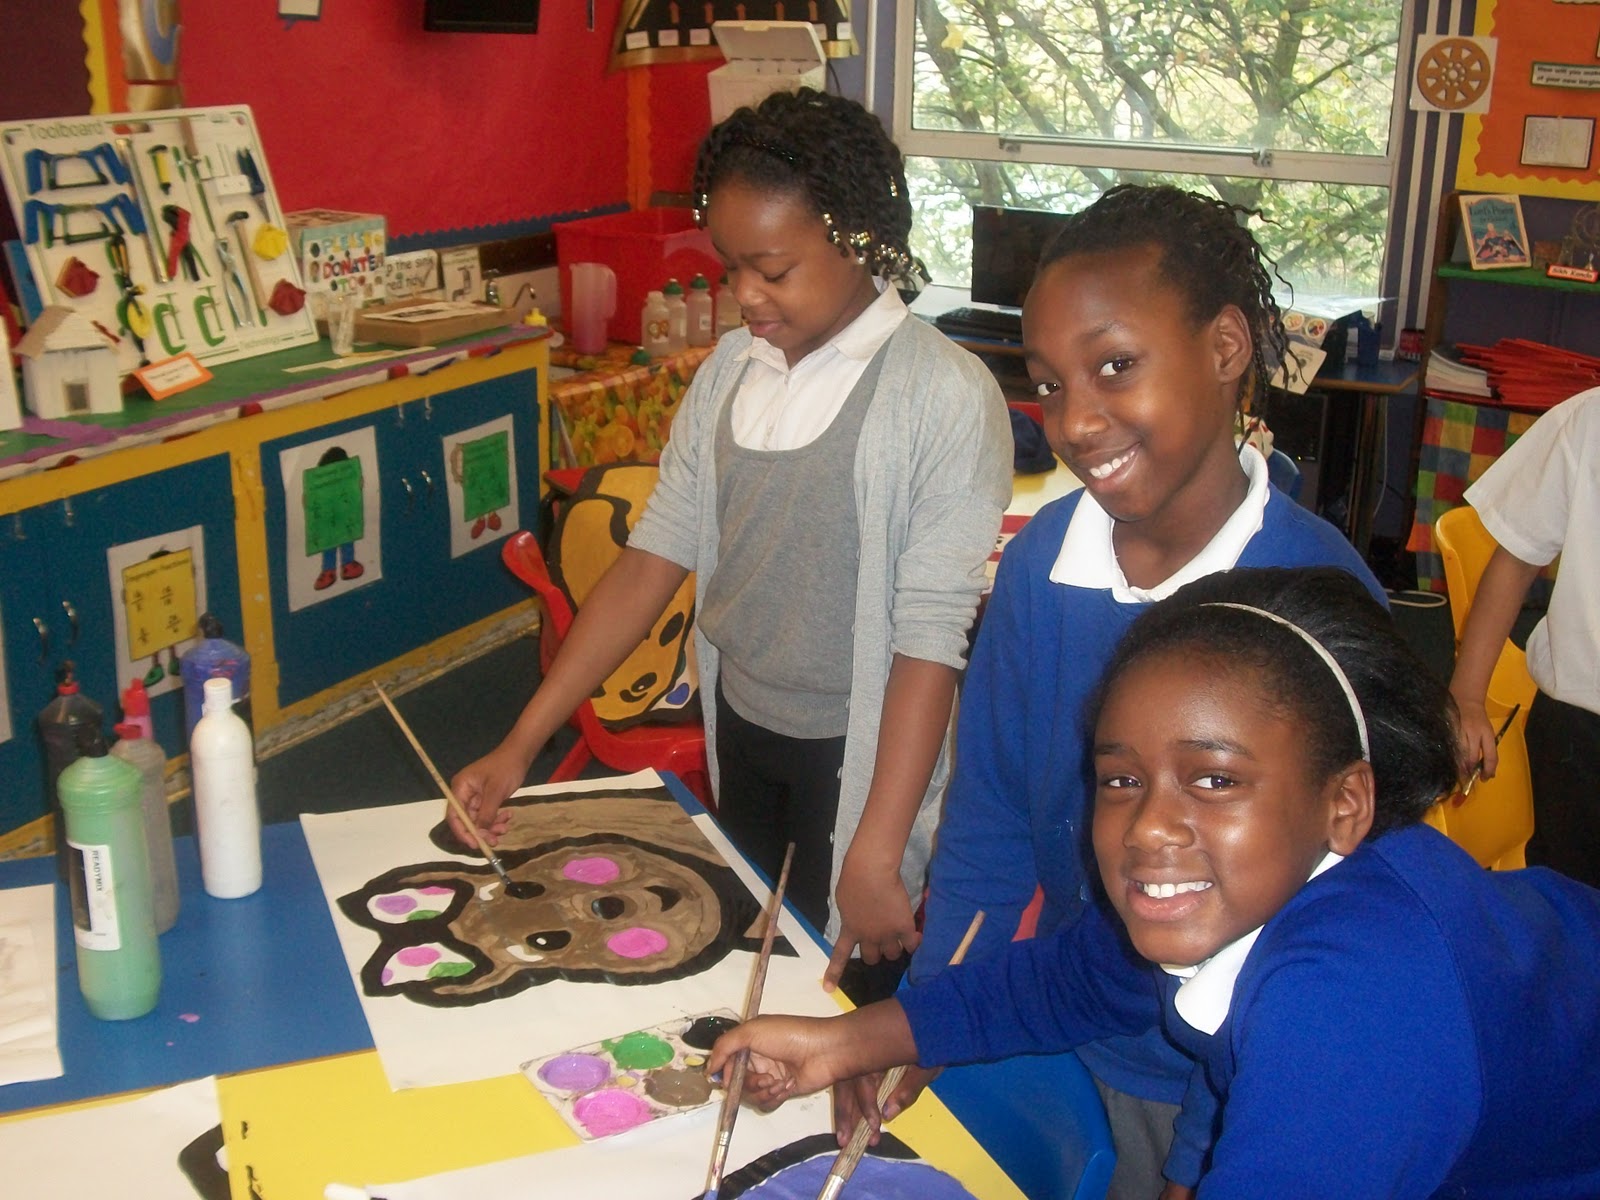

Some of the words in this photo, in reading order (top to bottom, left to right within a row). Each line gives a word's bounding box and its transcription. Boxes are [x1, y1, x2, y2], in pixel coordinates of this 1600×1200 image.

[24, 120, 104, 141] Toolboard
[321, 230, 372, 255] PLEASE
[323, 254, 375, 279] DONATE
[92, 850, 103, 892] READYMIX
